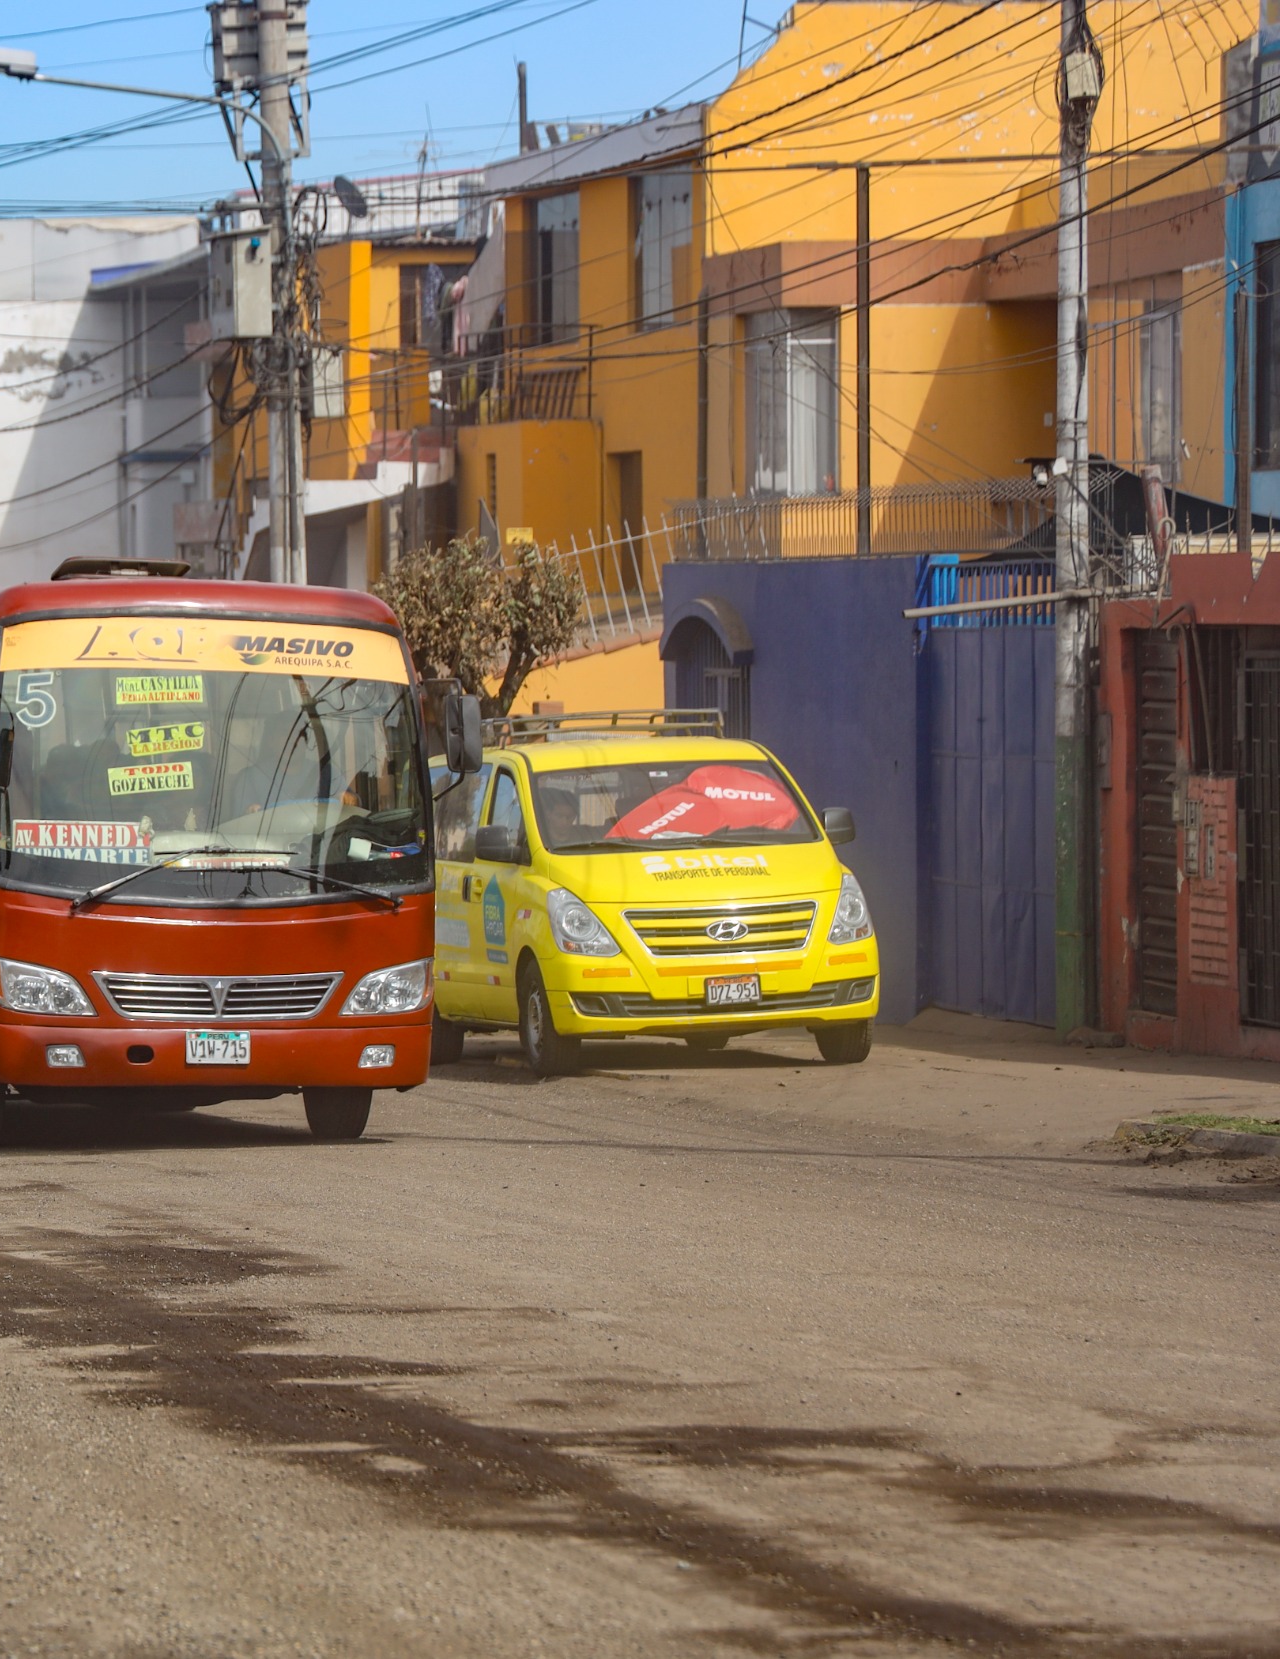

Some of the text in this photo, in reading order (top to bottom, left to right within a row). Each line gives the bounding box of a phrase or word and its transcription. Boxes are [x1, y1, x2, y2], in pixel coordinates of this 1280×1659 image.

[235, 635, 354, 658] MASIVO
[274, 656, 353, 669] AREQUIPA S.A.C.
[141, 676, 199, 691] CASTILLA
[16, 671, 57, 728] 5
[148, 691, 200, 702] ALTIPLANO
[131, 739, 201, 754] LA REGION
[124, 763, 184, 776] TODO
[111, 774, 190, 793] GOYENECHE
[704, 786, 776, 802] MOTUL
[638, 801, 695, 835] MOTUL
[16, 824, 146, 847] AV. KENNEDY
[63, 848, 148, 864] MARTE
[675, 855, 768, 869] bitel
[652, 865, 771, 882] TRANSPORTE DE PERSONAL
[711, 982, 759, 1000] D7Z-951
[190, 1041, 247, 1058] V1W-715
